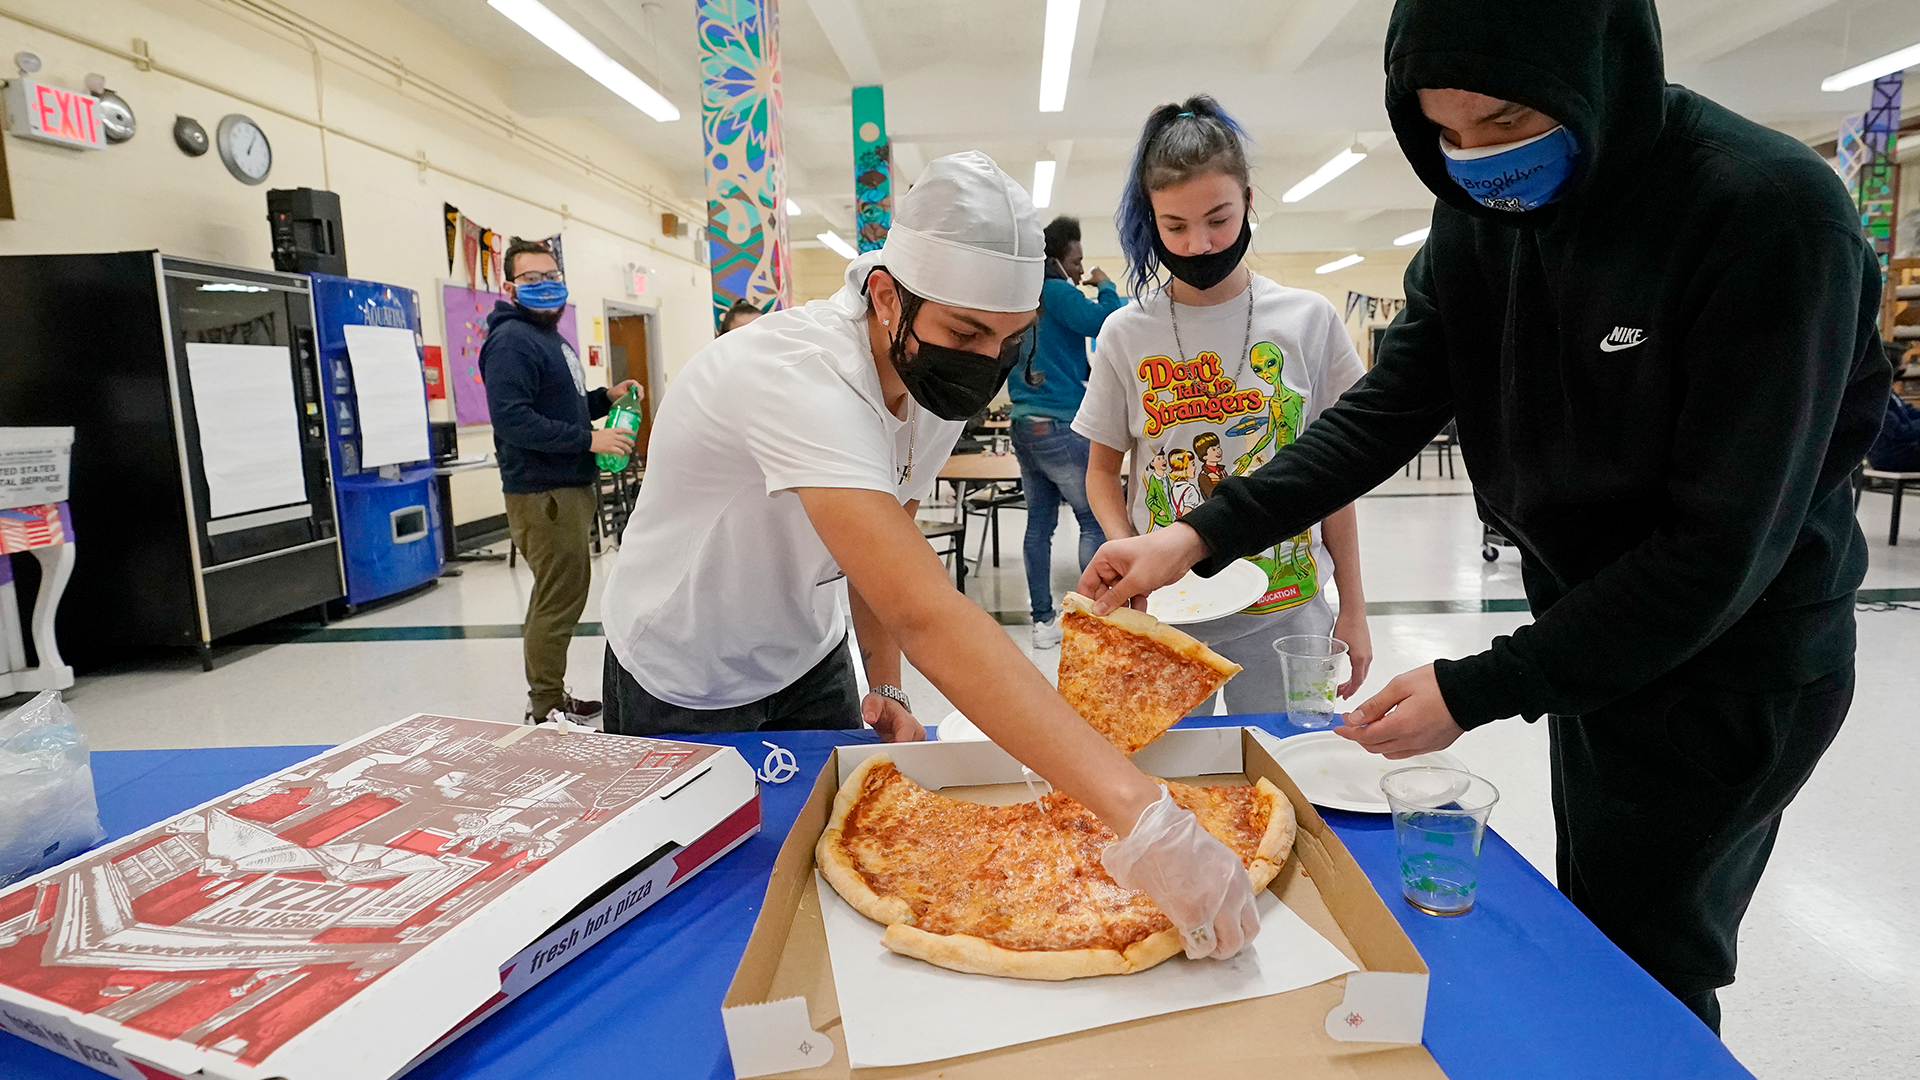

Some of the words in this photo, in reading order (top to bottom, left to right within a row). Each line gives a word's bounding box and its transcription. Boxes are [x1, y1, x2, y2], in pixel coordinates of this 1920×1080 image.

[34, 84, 97, 144] EXIT
[1462, 164, 1544, 190] Brooklyn
[1609, 326, 1643, 343] NIKE
[1139, 354, 1221, 389] Don't
[1213, 378, 1234, 396] to
[1142, 391, 1263, 435] Strangers
[19, 464, 57, 475] STATES
[20, 474, 61, 486] SERVICE
[238, 878, 371, 913] PIZZA
[198, 907, 267, 928] HOT
[254, 912, 335, 929] FRESH
[529, 928, 580, 975] fresh
[582, 904, 613, 940] hot
[612, 879, 653, 923] pizza
